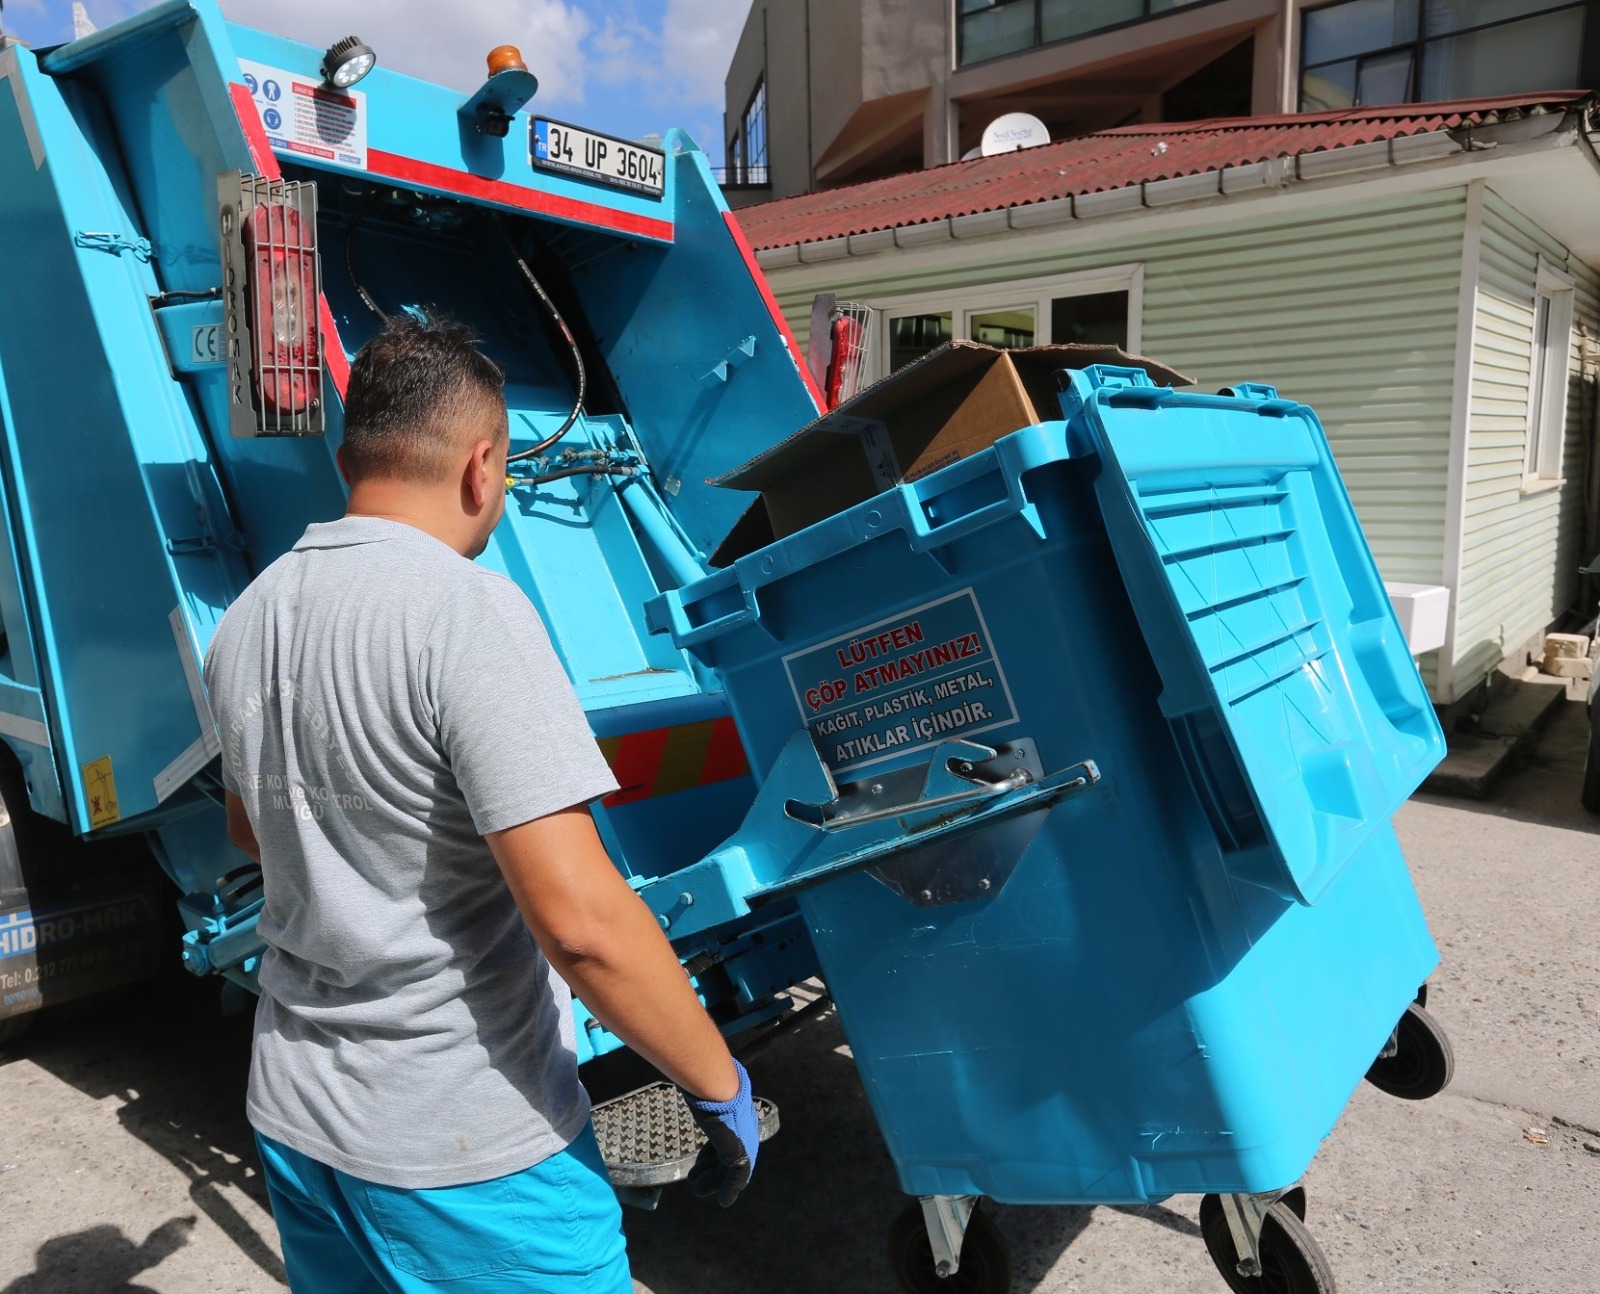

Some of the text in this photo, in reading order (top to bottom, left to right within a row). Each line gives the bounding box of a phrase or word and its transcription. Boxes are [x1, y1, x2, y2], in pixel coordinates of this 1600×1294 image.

[538, 141, 548, 153] TR
[550, 128, 658, 185] 34 UP 3604
[195, 326, 217, 358] CE
[837, 621, 924, 669] LÜTFEN
[805, 632, 983, 713] ÇÖP ATMAYINIZ!
[816, 671, 994, 737] KAĞIT, PLASTİK, METAL,
[836, 701, 994, 762] ATIKLAR İÇİNDİR.
[1, 971, 21, 990] Tel:
